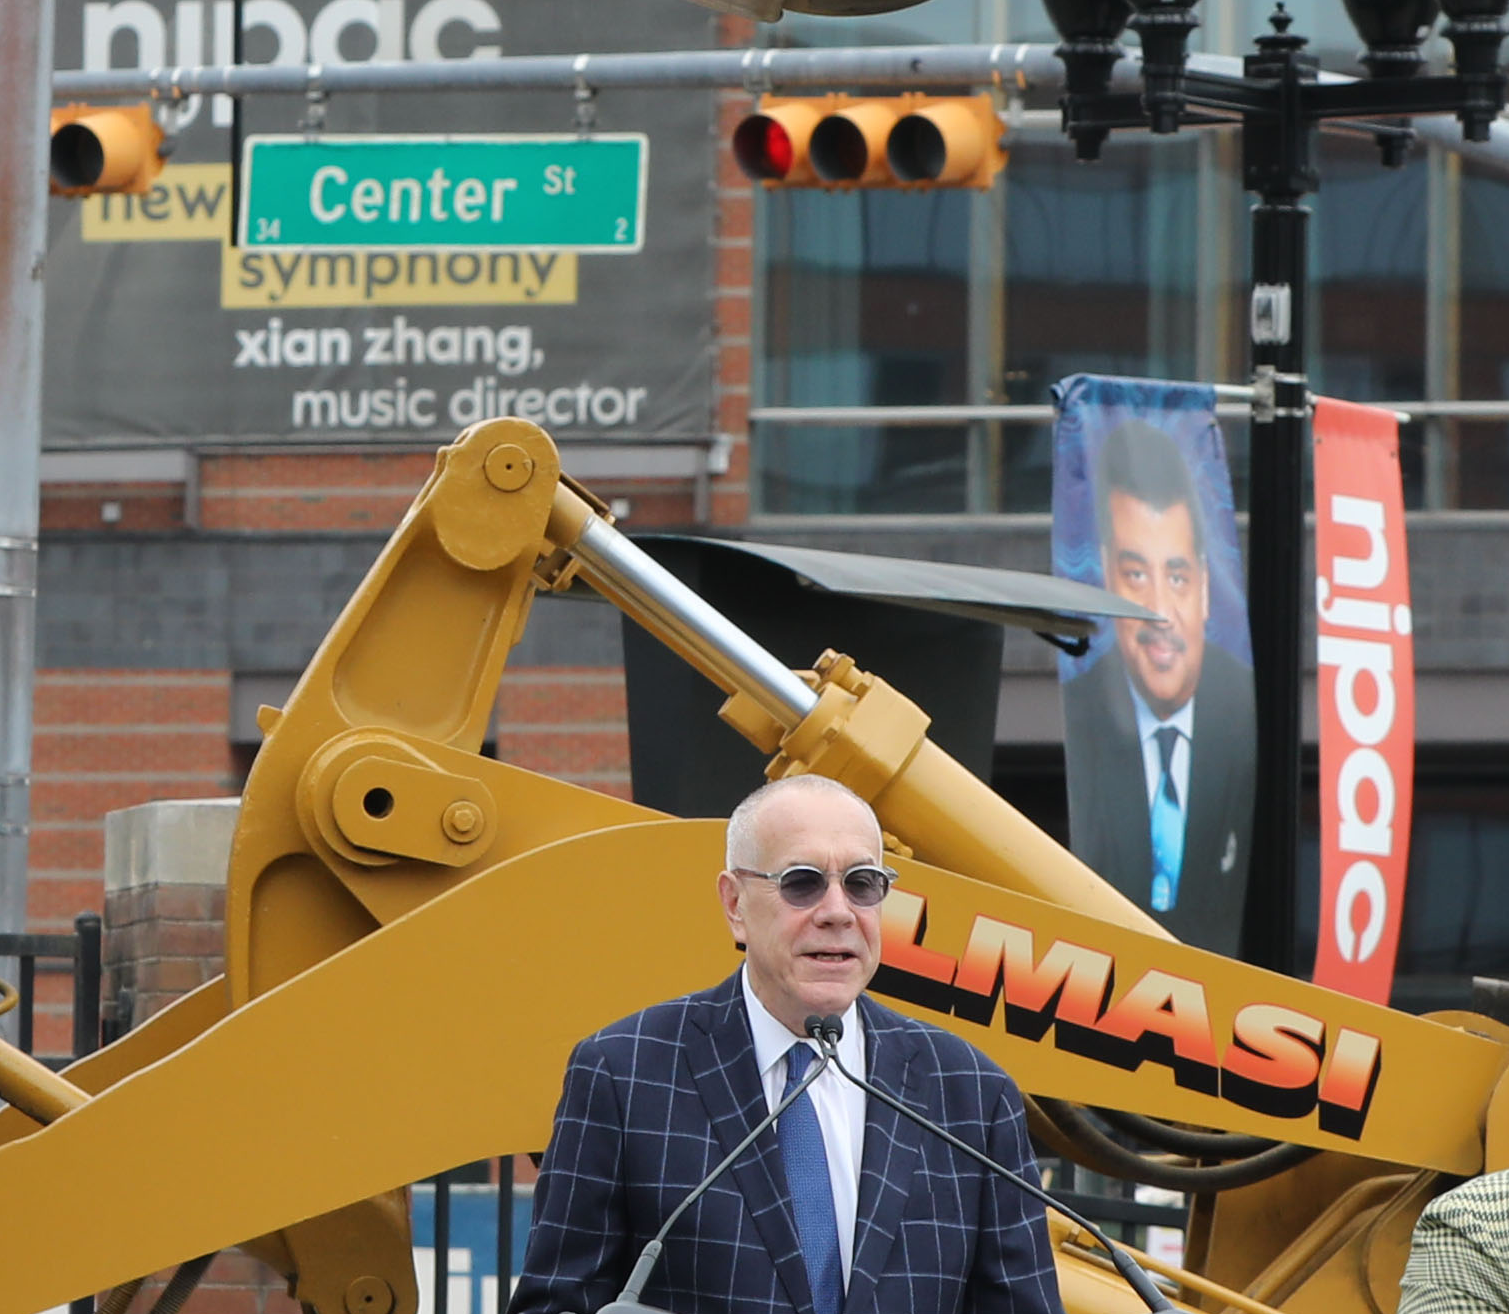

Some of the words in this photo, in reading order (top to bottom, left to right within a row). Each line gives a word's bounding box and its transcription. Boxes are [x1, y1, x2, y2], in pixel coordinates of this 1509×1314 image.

[310, 166, 517, 222] Center
[542, 165, 575, 194] St
[256, 218, 280, 241] 34
[615, 218, 628, 241] 2
[235, 319, 350, 366] xian
[363, 317, 544, 373] zhang,
[293, 382, 436, 428] music
[450, 378, 646, 425] director
[1316, 495, 1412, 963] njpac
[867, 887, 1381, 1140] LMASI
